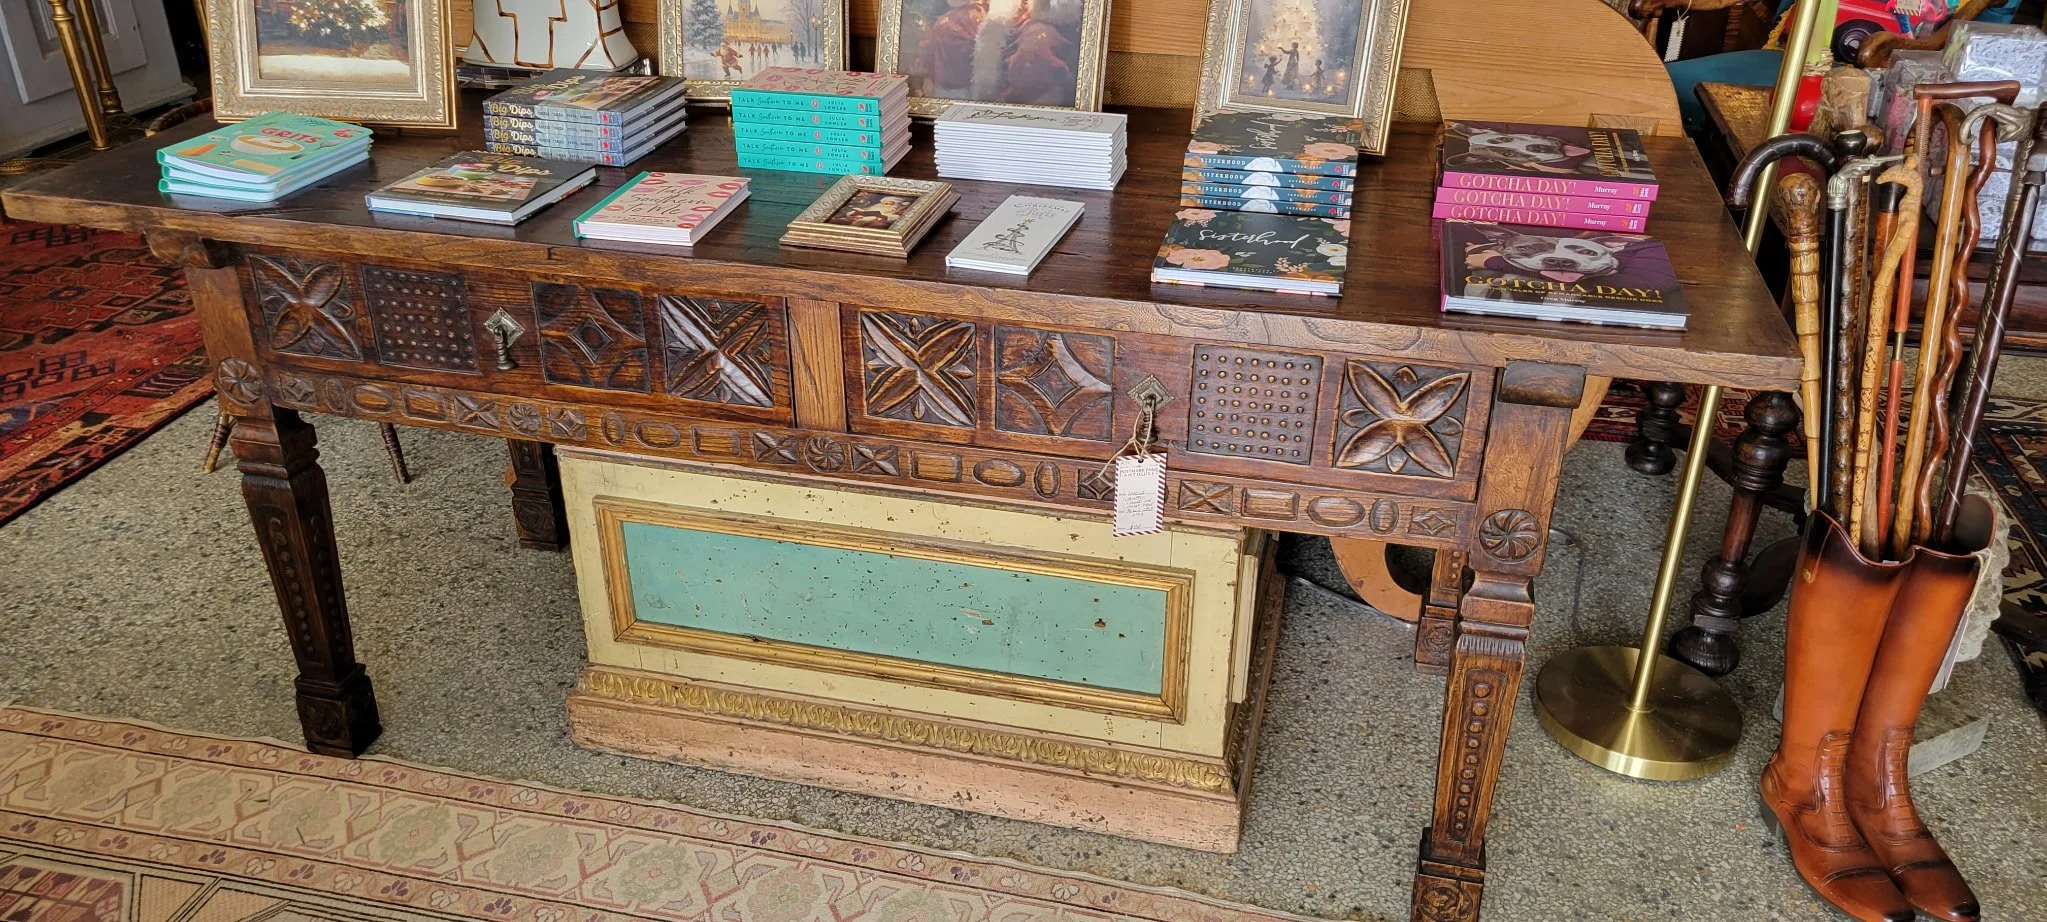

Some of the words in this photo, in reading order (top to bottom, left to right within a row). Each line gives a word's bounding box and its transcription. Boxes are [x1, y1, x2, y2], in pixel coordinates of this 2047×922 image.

[758, 96, 780, 106] Southern
[490, 102, 508, 114] Big
[509, 104, 532, 116] Dips
[758, 112, 781, 121] Southern
[491, 116, 509, 127] Big
[510, 118, 534, 129] Dips
[260, 127, 323, 145] GRITS
[492, 130, 510, 141] Big
[511, 130, 534, 142] Dips
[760, 127, 782, 136] Southern
[494, 142, 512, 154] Big
[512, 145, 536, 156] Dips
[762, 143, 784, 152] Southern
[763, 157, 785, 166] Southern
[1200, 158, 1246, 166] SISTERHOOD
[498, 164, 552, 176] Dips
[1198, 172, 1244, 180] SISTERHOOD
[656, 184, 708, 195] Talk
[1198, 186, 1242, 194] SISTERHOOD
[1459, 175, 1532, 191] GOTCHA
[1537, 180, 1577, 194] DAY!
[1594, 186, 1619, 195] Murray
[620, 192, 708, 206] Southern
[1196, 198, 1242, 207] SISTERHOOD
[1453, 189, 1526, 208] GOTCHA
[1531, 196, 1570, 210] DAY!
[1587, 202, 1612, 212] Murray
[1450, 205, 1522, 224] GOTCHA
[1526, 212, 1566, 226] DAY!
[1583, 217, 1608, 227] Murray
[1198, 229, 1310, 249] Sisterhood
[1464, 275, 1588, 292] GOTCHA
[1596, 285, 1662, 299] DAY!
